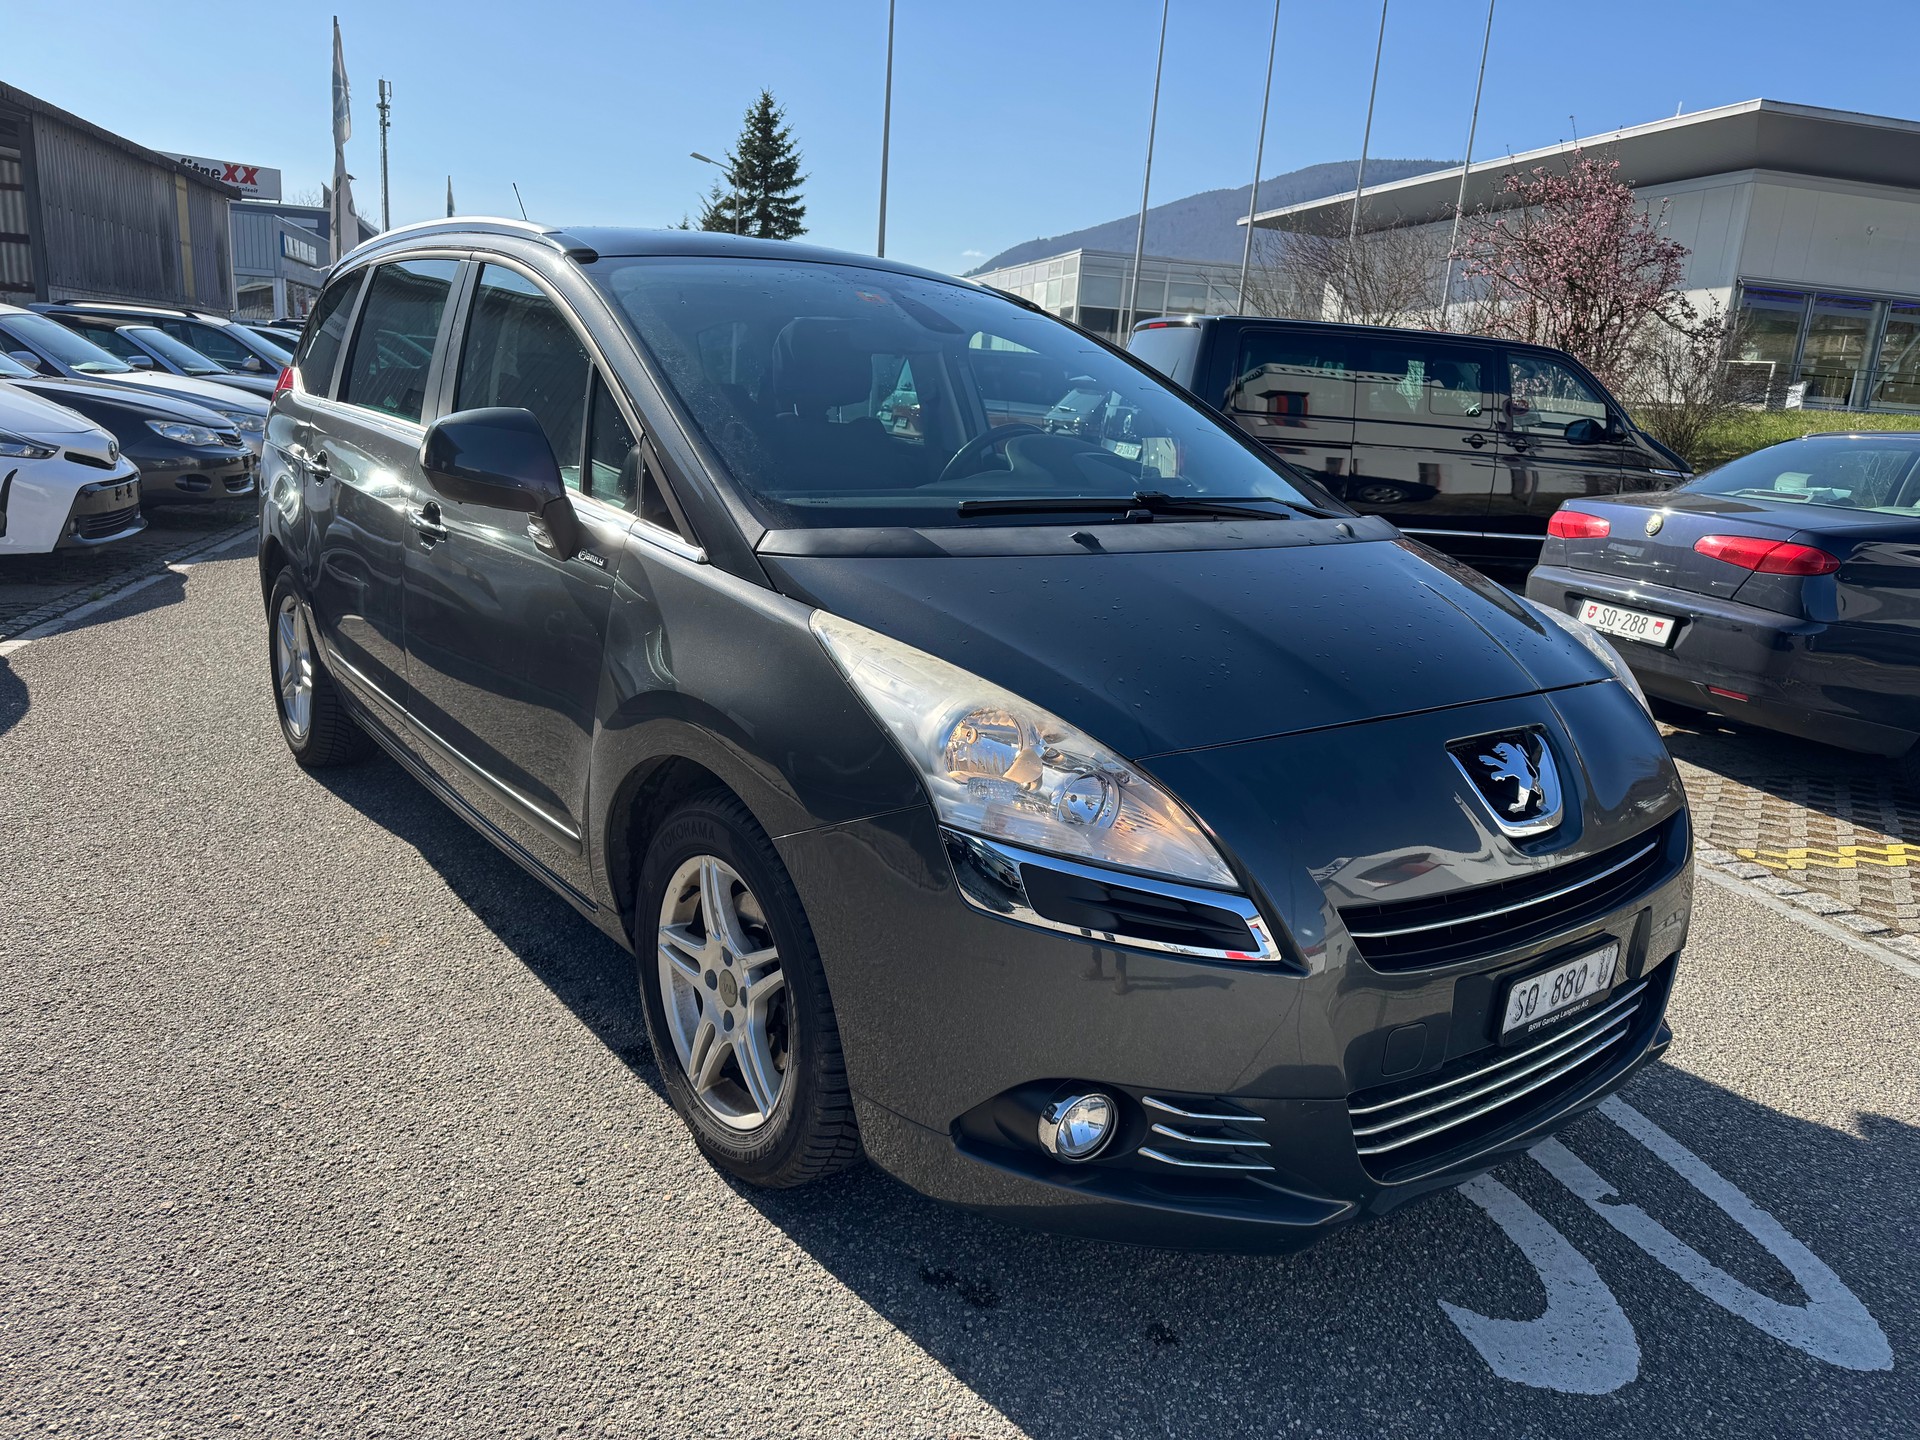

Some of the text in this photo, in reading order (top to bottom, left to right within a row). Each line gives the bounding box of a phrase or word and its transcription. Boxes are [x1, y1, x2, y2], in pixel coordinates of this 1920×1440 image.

[1541, 1013, 1560, 1026] Garage
[1560, 1005, 1581, 1019] Langnau
[1580, 999, 1590, 1010] AG
